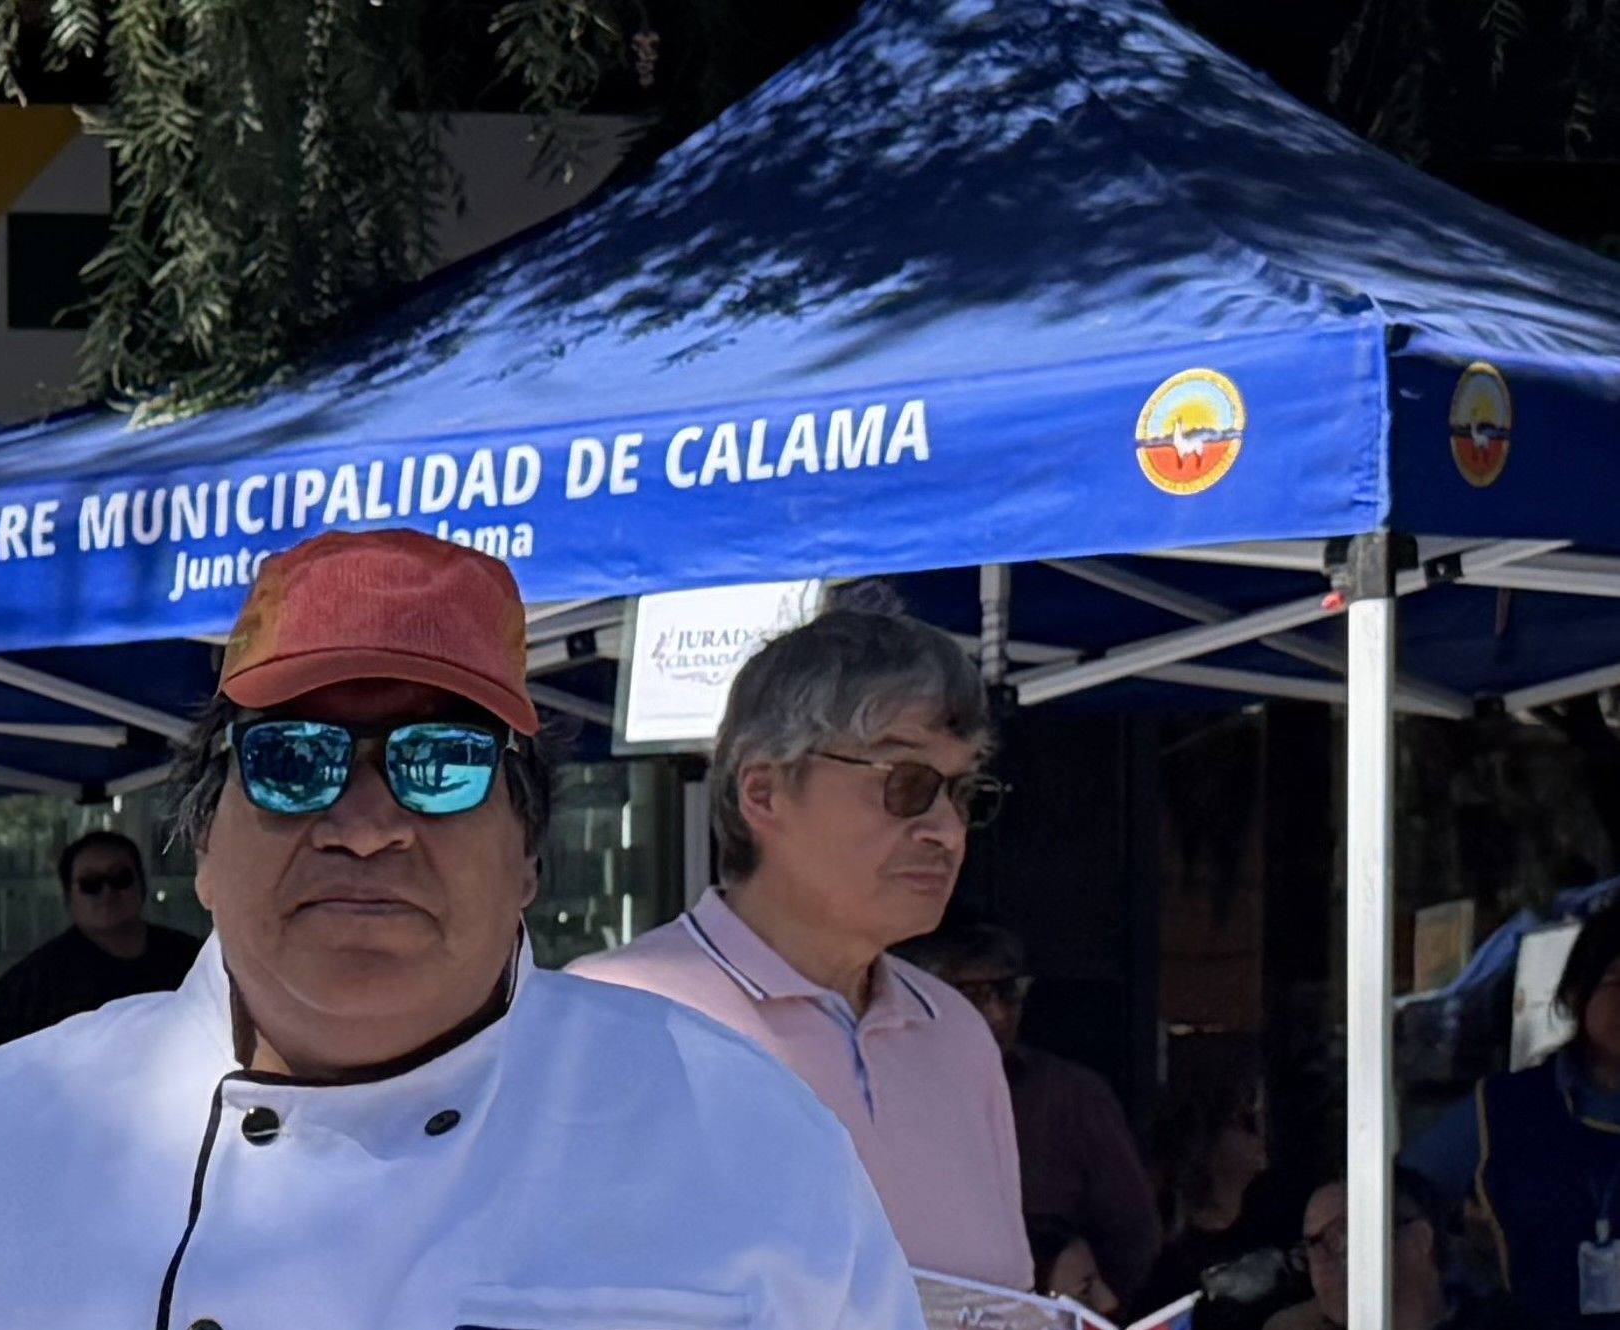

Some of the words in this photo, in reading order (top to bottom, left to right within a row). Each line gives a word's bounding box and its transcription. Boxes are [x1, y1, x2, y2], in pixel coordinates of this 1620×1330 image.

[78, 444, 542, 552] MUNICIPALIDAD
[566, 433, 644, 500] DE
[666, 400, 931, 489] CALAMA
[168, 547, 271, 602] Junt
[437, 519, 533, 560] lama
